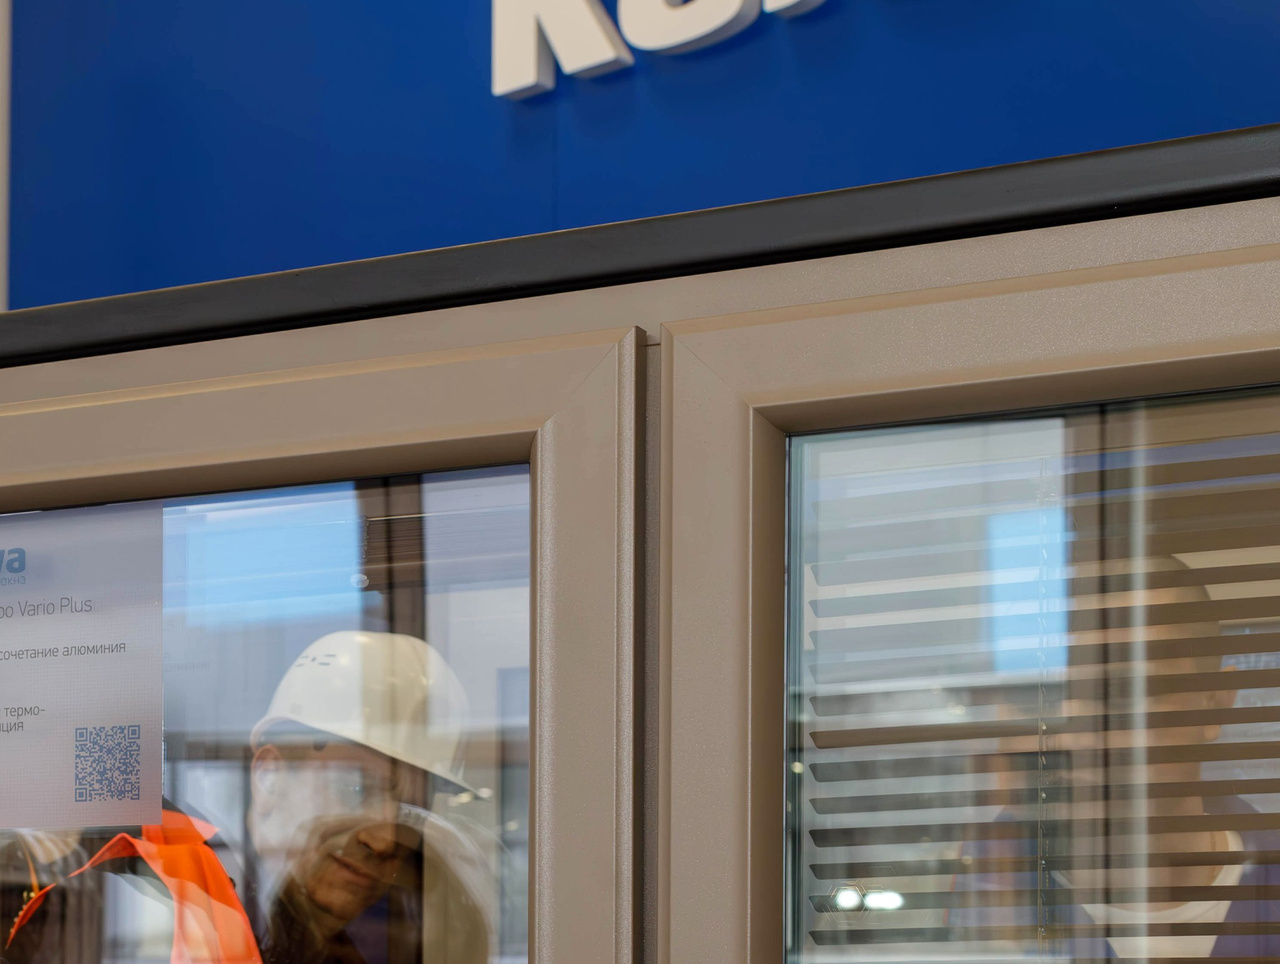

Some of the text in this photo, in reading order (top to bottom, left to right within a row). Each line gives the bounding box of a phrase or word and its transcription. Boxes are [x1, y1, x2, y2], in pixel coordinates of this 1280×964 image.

[18, 599, 55, 617] Vario
[60, 597, 93, 614] Plus
[63, 642, 126, 656] алюминия
[4, 705, 46, 719] термо-
